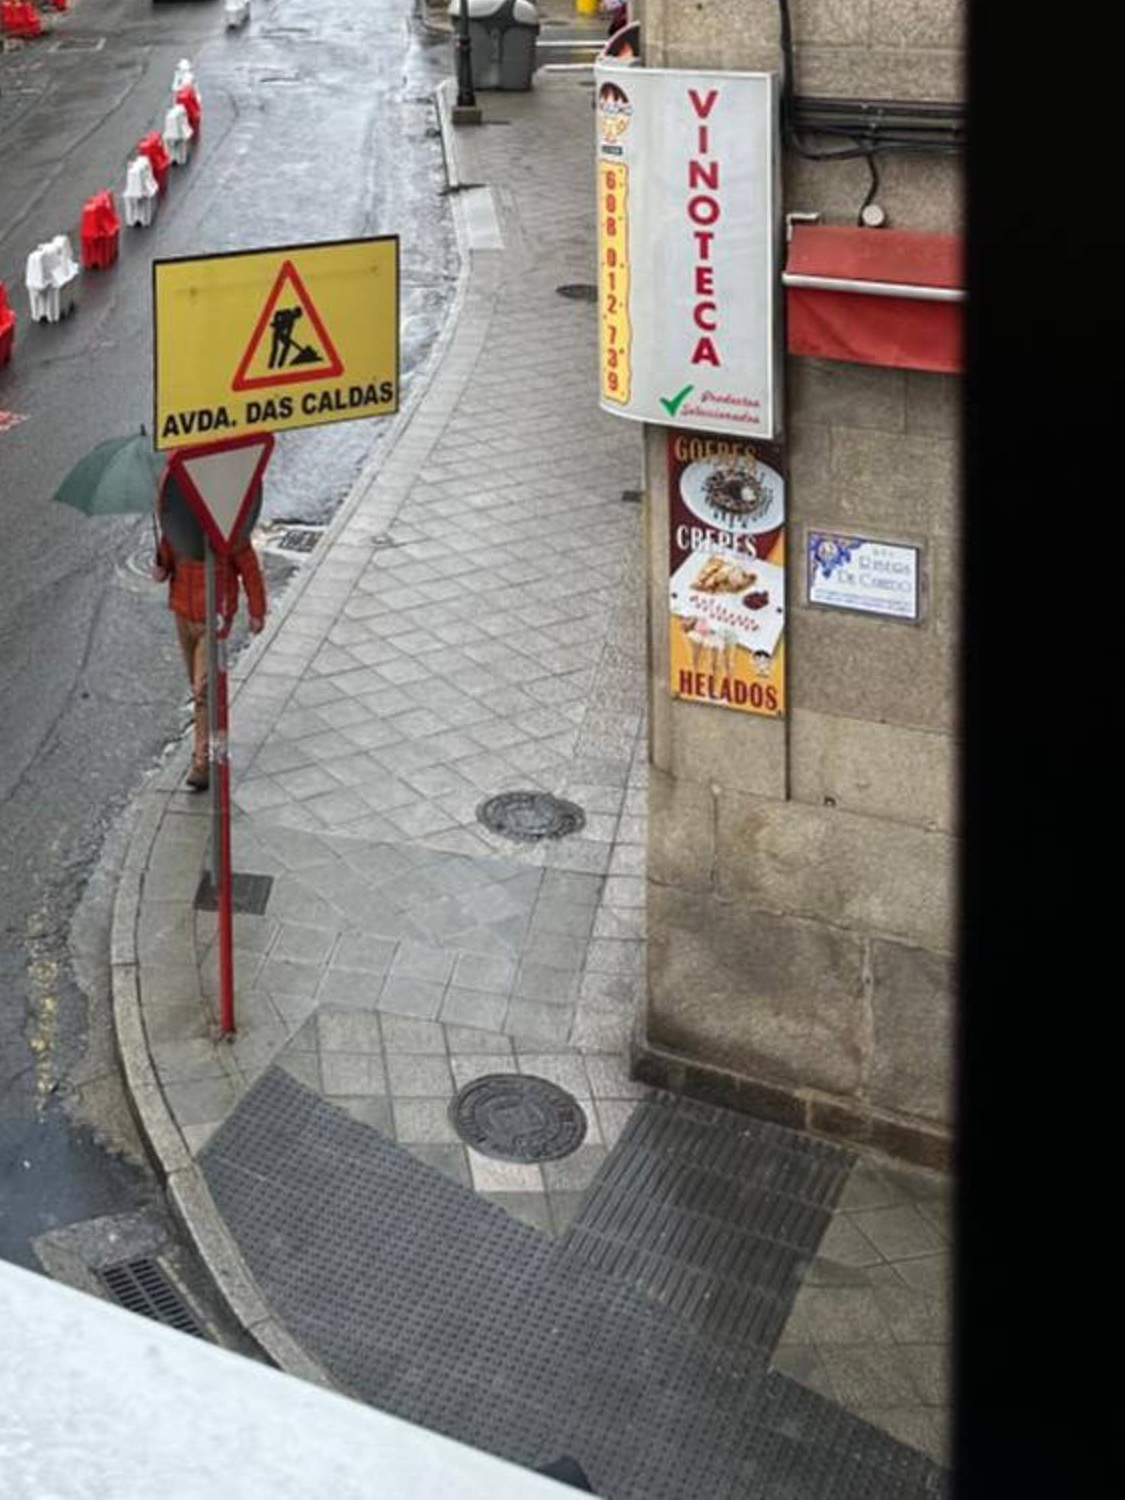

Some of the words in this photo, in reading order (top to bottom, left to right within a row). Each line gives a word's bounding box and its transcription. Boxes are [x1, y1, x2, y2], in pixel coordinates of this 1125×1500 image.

[687, 89, 721, 367] VINOTECA
[162, 406, 237, 438] AVDA.
[246, 396, 294, 424] DAS
[301, 381, 394, 415] CALDAS
[679, 668, 778, 711] HELADOS
